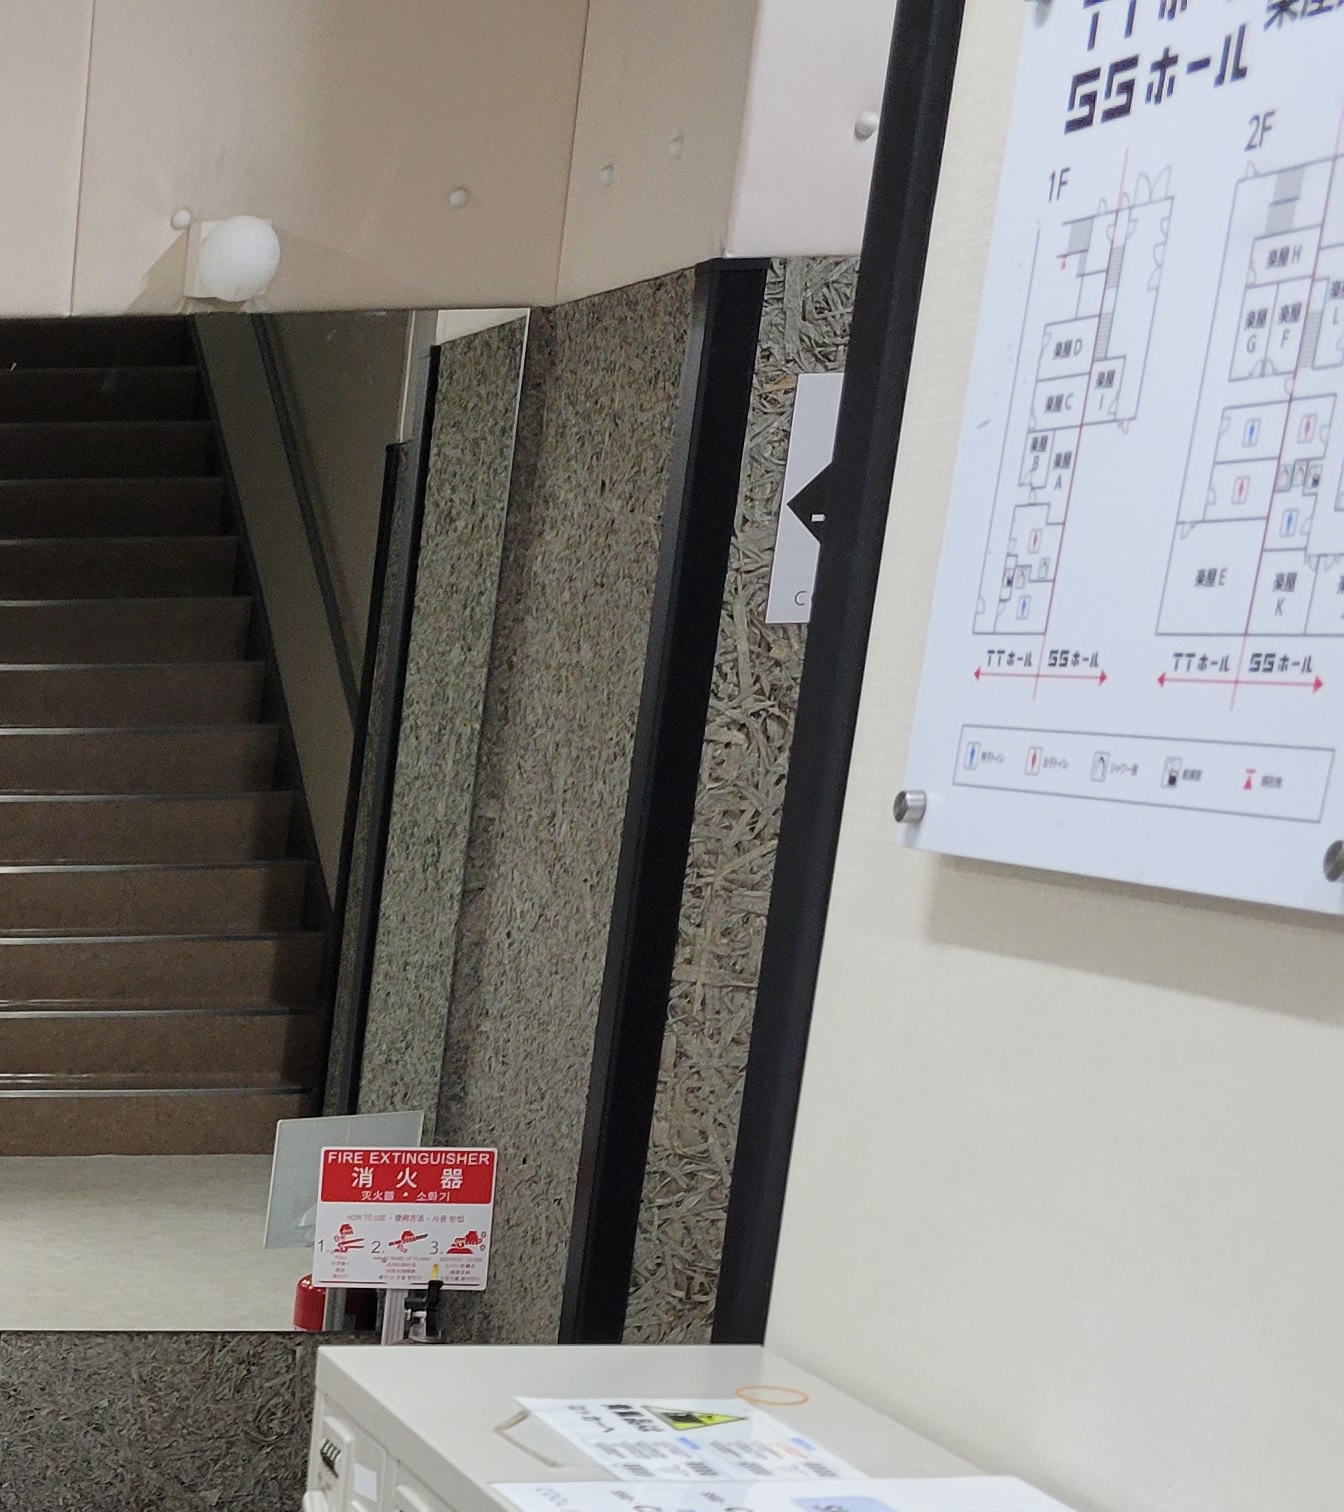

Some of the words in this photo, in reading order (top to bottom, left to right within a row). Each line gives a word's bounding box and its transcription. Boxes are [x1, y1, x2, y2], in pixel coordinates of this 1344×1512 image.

[1064, 22, 1248, 135] SSホール
[1244, 110, 1276, 152] 2F
[1047, 167, 1071, 204] 1F
[1291, 244, 1303, 263] H
[1074, 339, 1082, 356] D
[1247, 334, 1257, 354] G
[1280, 329, 1291, 349] F
[1065, 393, 1074, 410] C
[1054, 474, 1062, 490] A
[1218, 568, 1228, 586] E
[1275, 597, 1286, 616] K
[987, 650, 1032, 668] TTホール
[1048, 650, 1099, 668] SSホール
[1173, 652, 1230, 672] TTホール
[1248, 652, 1312, 673] SSホール
[328, 1152, 363, 1164] FIRE
[369, 1152, 490, 1165] EXTINGUISHER
[351, 1166, 463, 1190] 消火器
[372, 1240, 385, 1254] 2.
[430, 1240, 443, 1254] 3.
